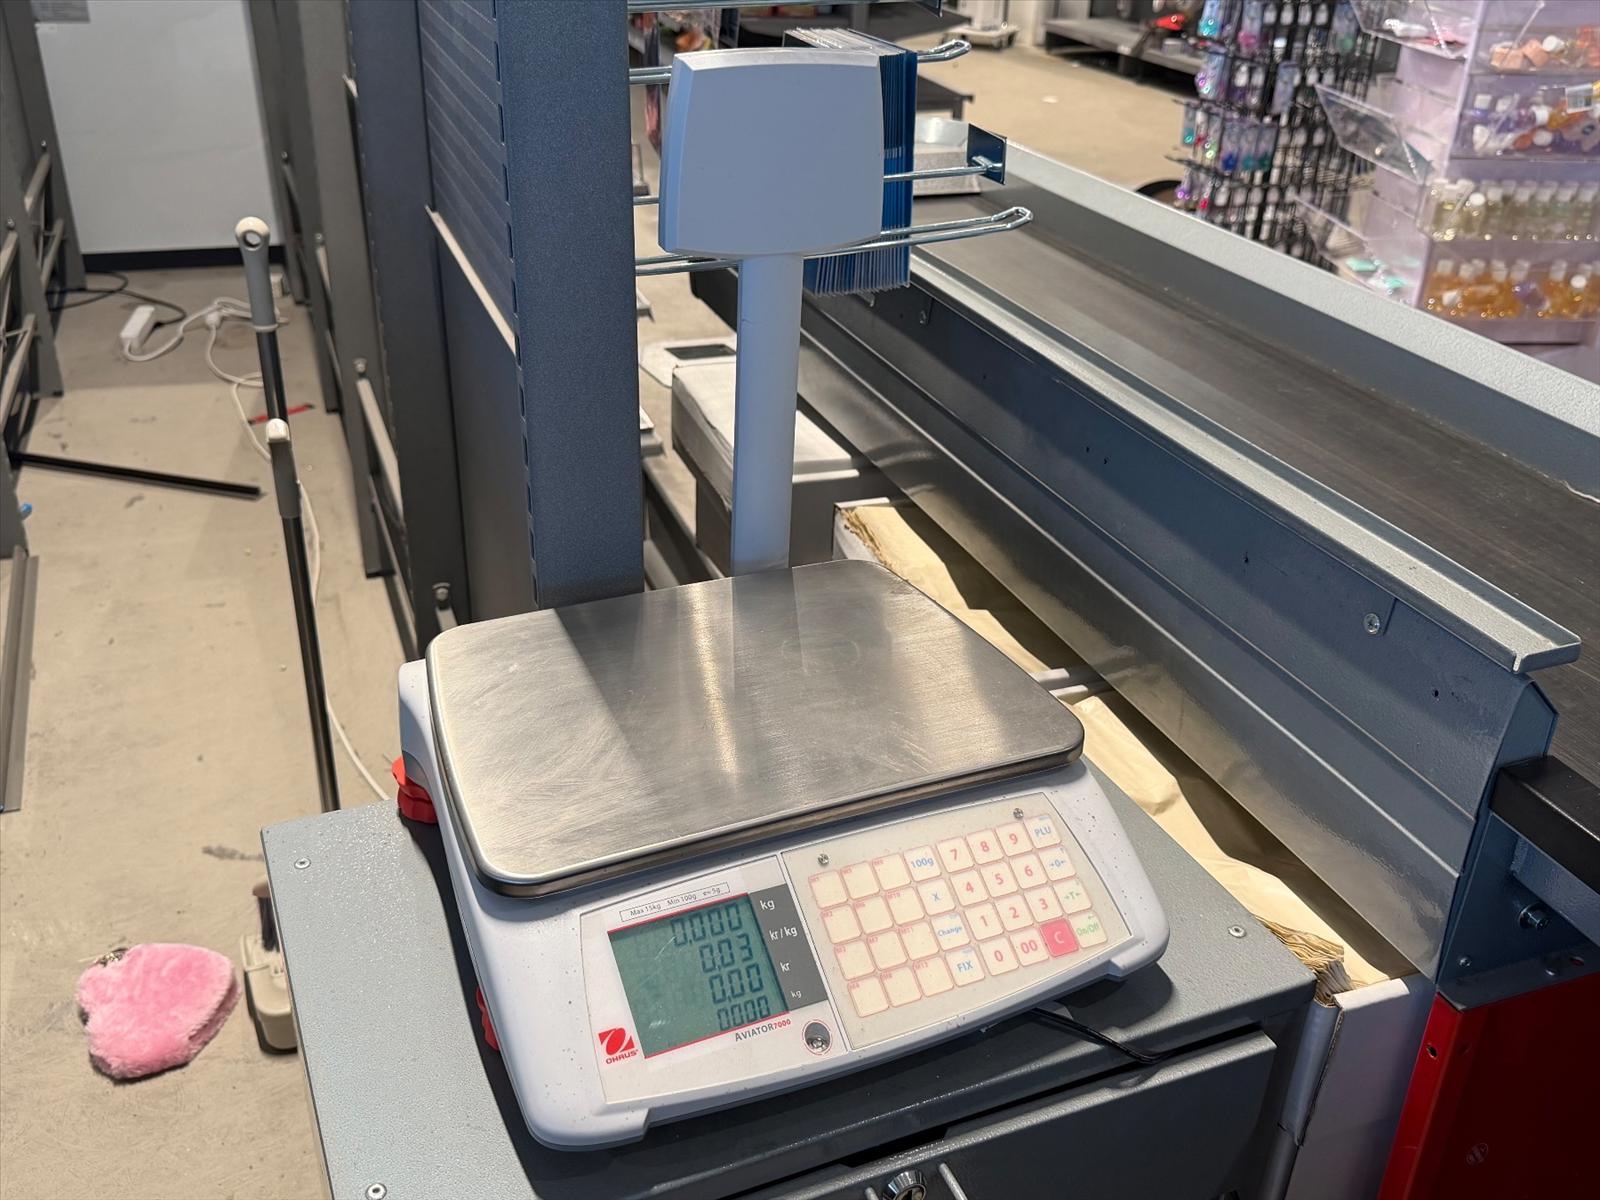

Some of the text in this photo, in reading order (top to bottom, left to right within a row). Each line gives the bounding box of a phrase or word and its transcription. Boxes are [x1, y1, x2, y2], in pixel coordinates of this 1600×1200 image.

[1034, 826, 1052, 837] PLU
[950, 833, 1018, 861] 7 8 9
[911, 857, 935, 868] 100g
[966, 865, 1033, 893] 4 5 6
[759, 899, 775, 911] kg
[980, 898, 1048, 927] 1 2 3
[937, 926, 962, 937] Change
[1076, 922, 1099, 936] On/Off
[1053, 931, 1065, 944] C
[994, 940, 1038, 962] 0 00
[780, 961, 790, 972] kr
[957, 960, 973, 973] FIX
[791, 990, 802, 999] kg
[605, 1050, 637, 1065] OHAUS
